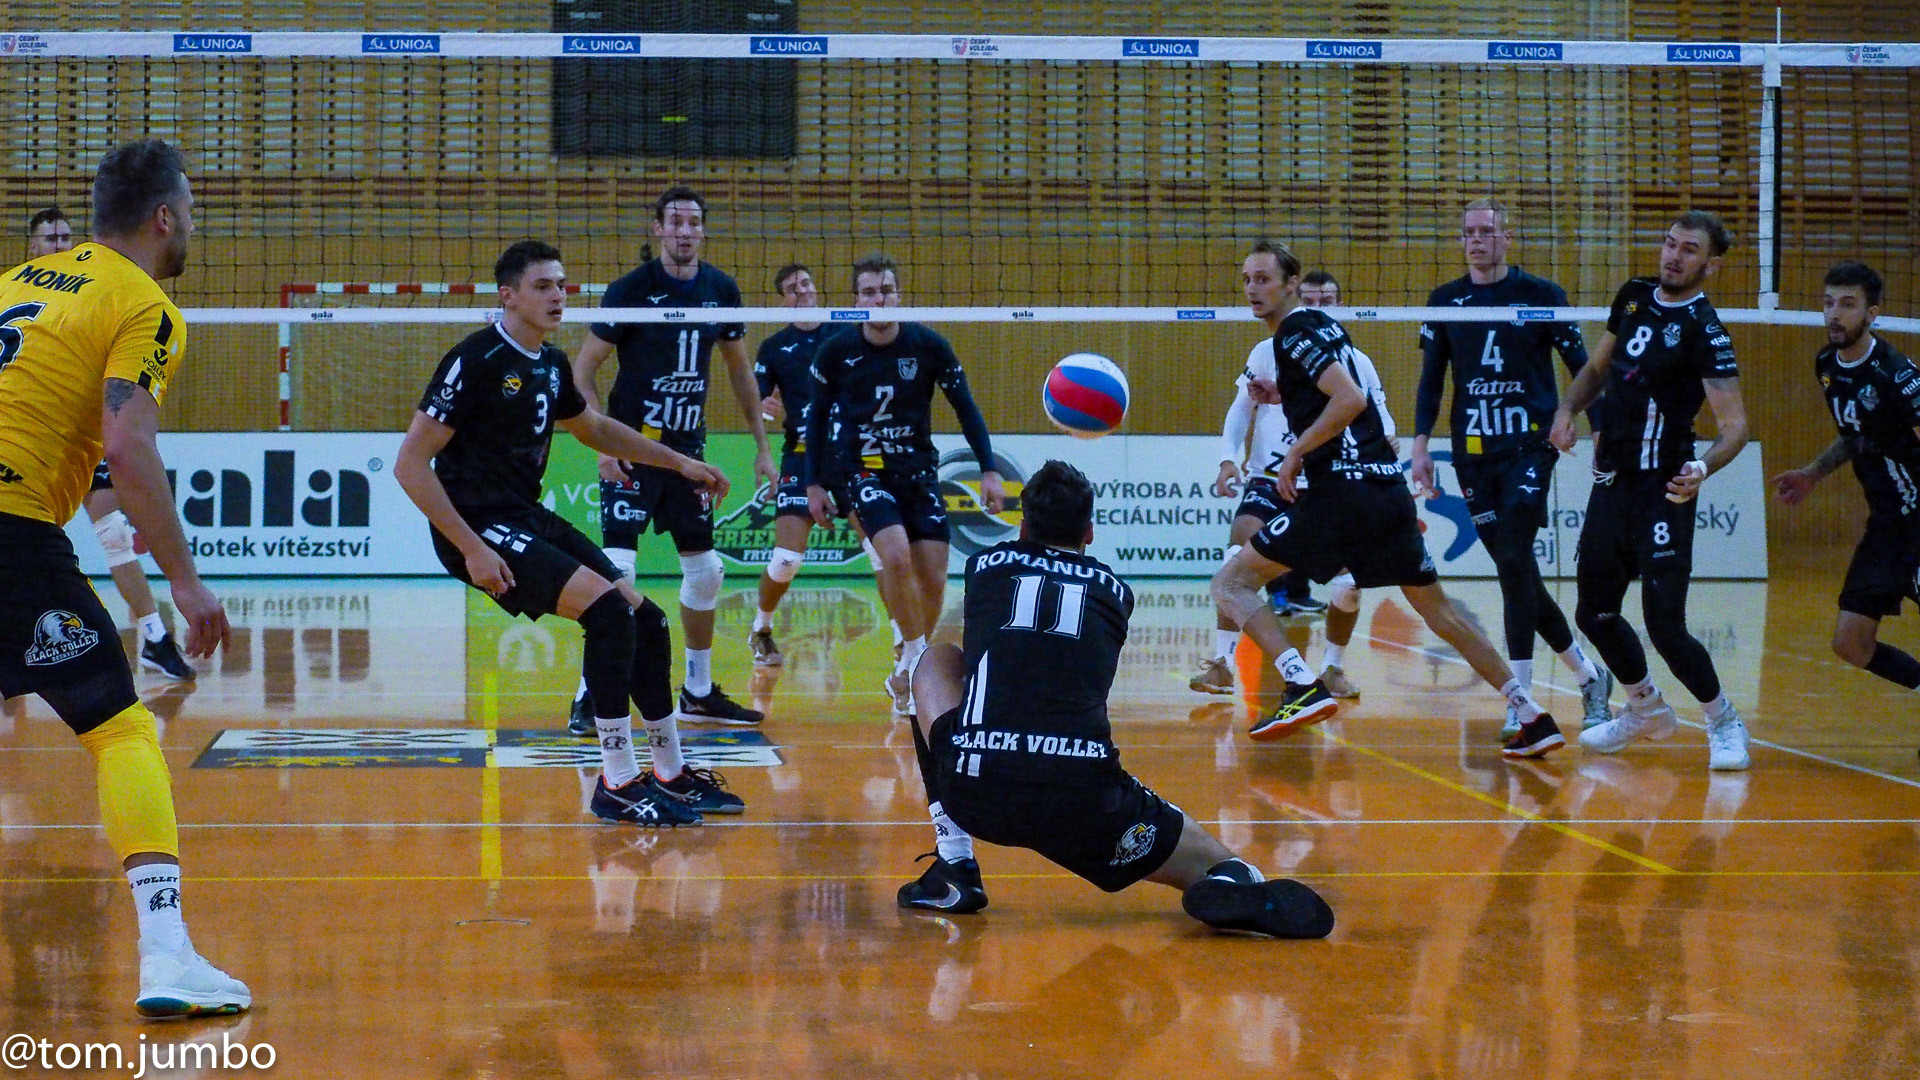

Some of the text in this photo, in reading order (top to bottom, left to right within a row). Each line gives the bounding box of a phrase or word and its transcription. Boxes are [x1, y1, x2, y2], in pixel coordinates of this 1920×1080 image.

[201, 38, 245, 50] UNIQA
[389, 39, 434, 50] UNIQA
[590, 40, 634, 51] UNIQA
[778, 41, 822, 52] UNIQA
[1150, 43, 1193, 54] UNIQA
[1333, 45, 1375, 56] UNIQA
[1514, 46, 1557, 57] UNIQA
[1693, 49, 1736, 60] UNIQA
[11, 264, 95, 295] MONÍK
[311, 311, 333, 320] gala
[663, 311, 686, 320] gala
[1012, 310, 1034, 319] gala
[1626, 325, 1653, 357] 8
[673, 329, 699, 377] 11
[1481, 330, 1504, 372] 4
[652, 375, 705, 393] fatra
[1466, 377, 1525, 395] fatra
[873, 386, 894, 421] 2
[534, 393, 548, 434] 3
[1833, 396, 1861, 432] 14
[166, 450, 370, 527] ala
[1092, 479, 1182, 498] VÝROBA
[1189, 482, 1204, 498] A
[1096, 505, 1211, 525] ECIÁLNÍCH
[1266, 512, 1290, 535] 10
[806, 529, 860, 548] OLLE
[1653, 521, 1671, 545] 8
[188, 535, 371, 557] dotek vítězství
[974, 550, 1124, 603] ROMANUTTI
[1000, 574, 1088, 640] 11
[27, 633, 97, 664] BLACK VOLLEY
[952, 730, 1108, 759] BLACK VOLLEY
[136, 876, 178, 887] VOLLEY
